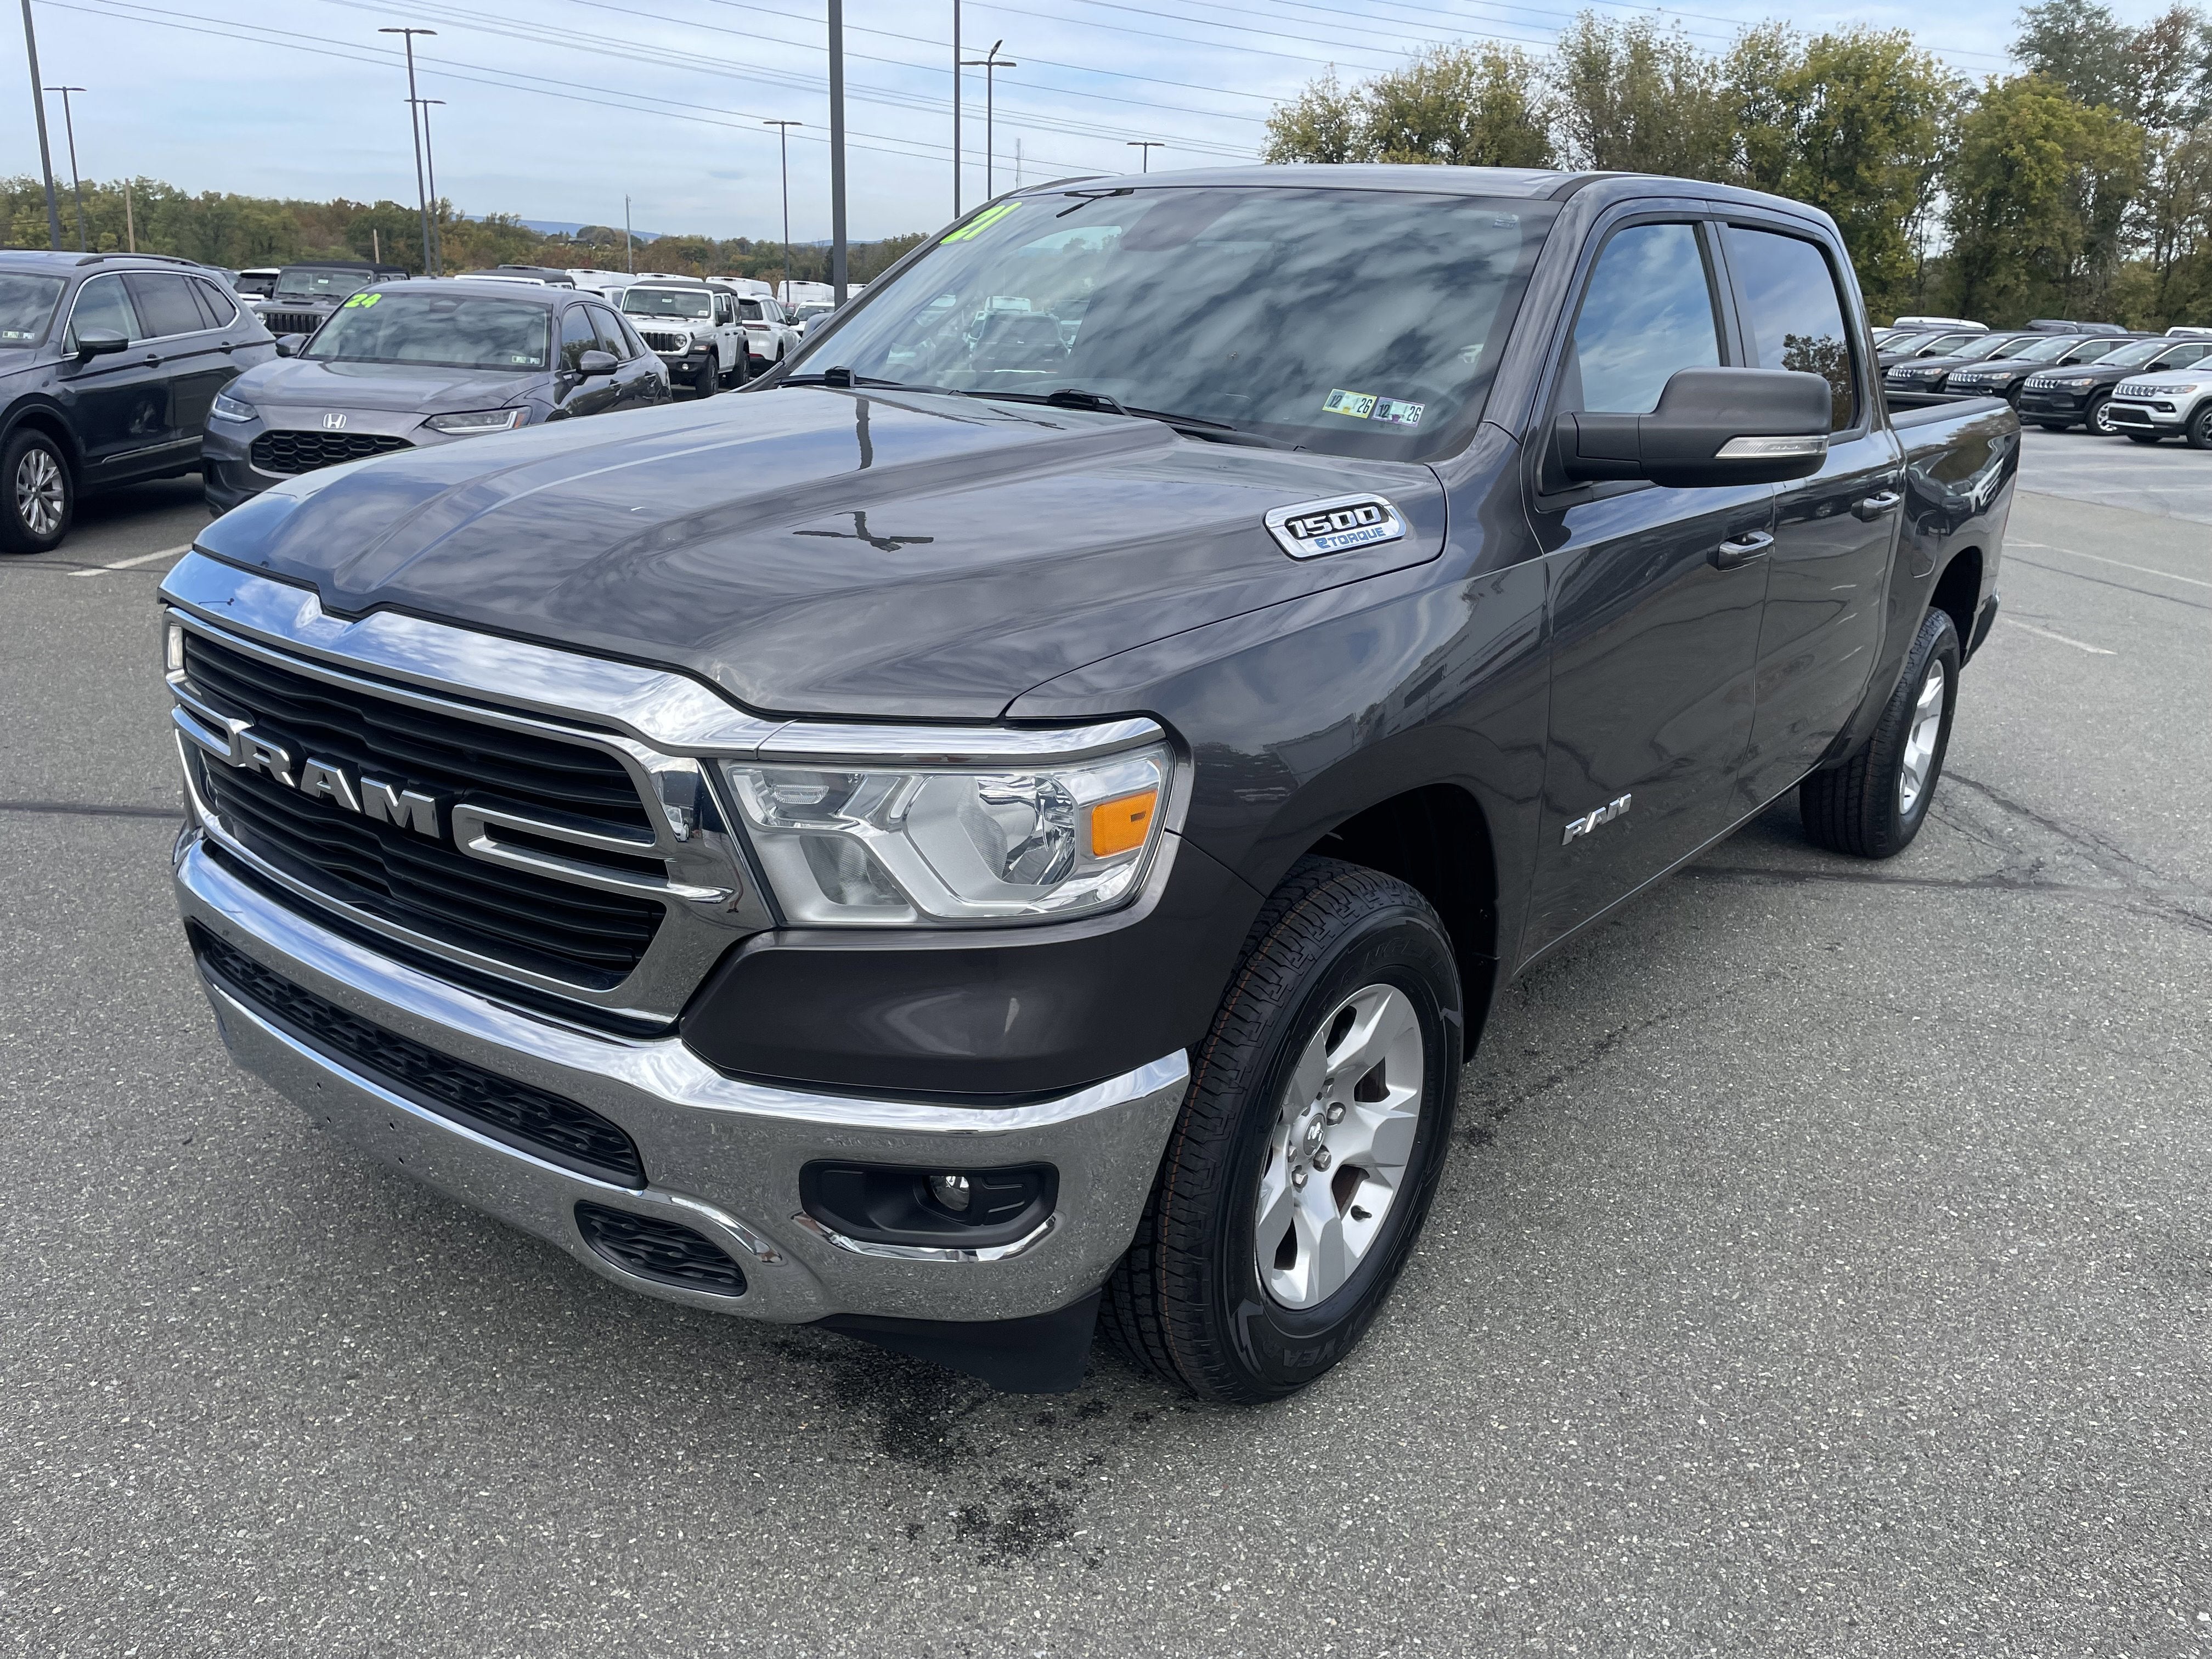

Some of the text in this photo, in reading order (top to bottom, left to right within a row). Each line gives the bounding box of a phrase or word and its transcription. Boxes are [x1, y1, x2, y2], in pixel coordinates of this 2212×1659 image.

[344, 294, 382, 308] 24
[1328, 395, 1373, 414] 12 26
[1379, 404, 1421, 422] 12 26
[1289, 506, 1381, 538] 1500
[239, 731, 439, 838] RAM
[1562, 793, 1632, 845] RAM
